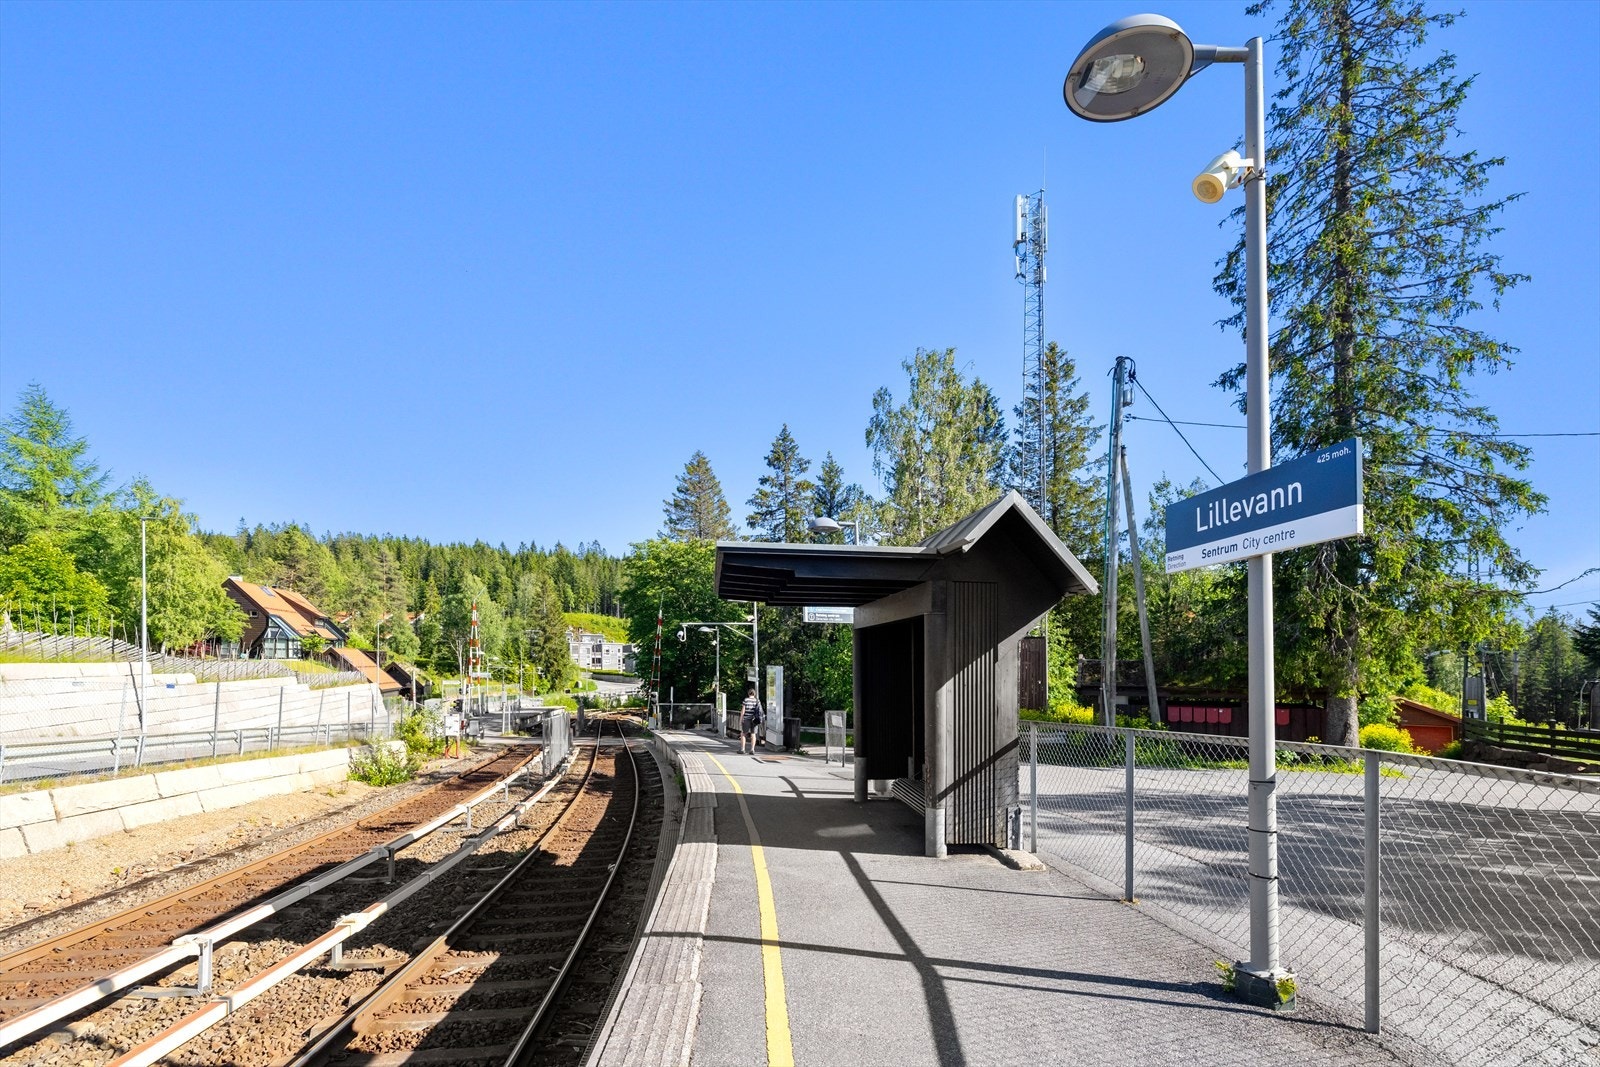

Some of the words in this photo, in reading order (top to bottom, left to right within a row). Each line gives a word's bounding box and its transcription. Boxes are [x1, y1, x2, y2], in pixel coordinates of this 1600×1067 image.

[1316, 453, 1331, 464] 425
[1331, 446, 1351, 459] moh.
[1196, 481, 1303, 532] Lillevann
[1201, 541, 1238, 559] Sentrum
[1242, 537, 1261, 551] City
[1263, 529, 1295, 545] centre
